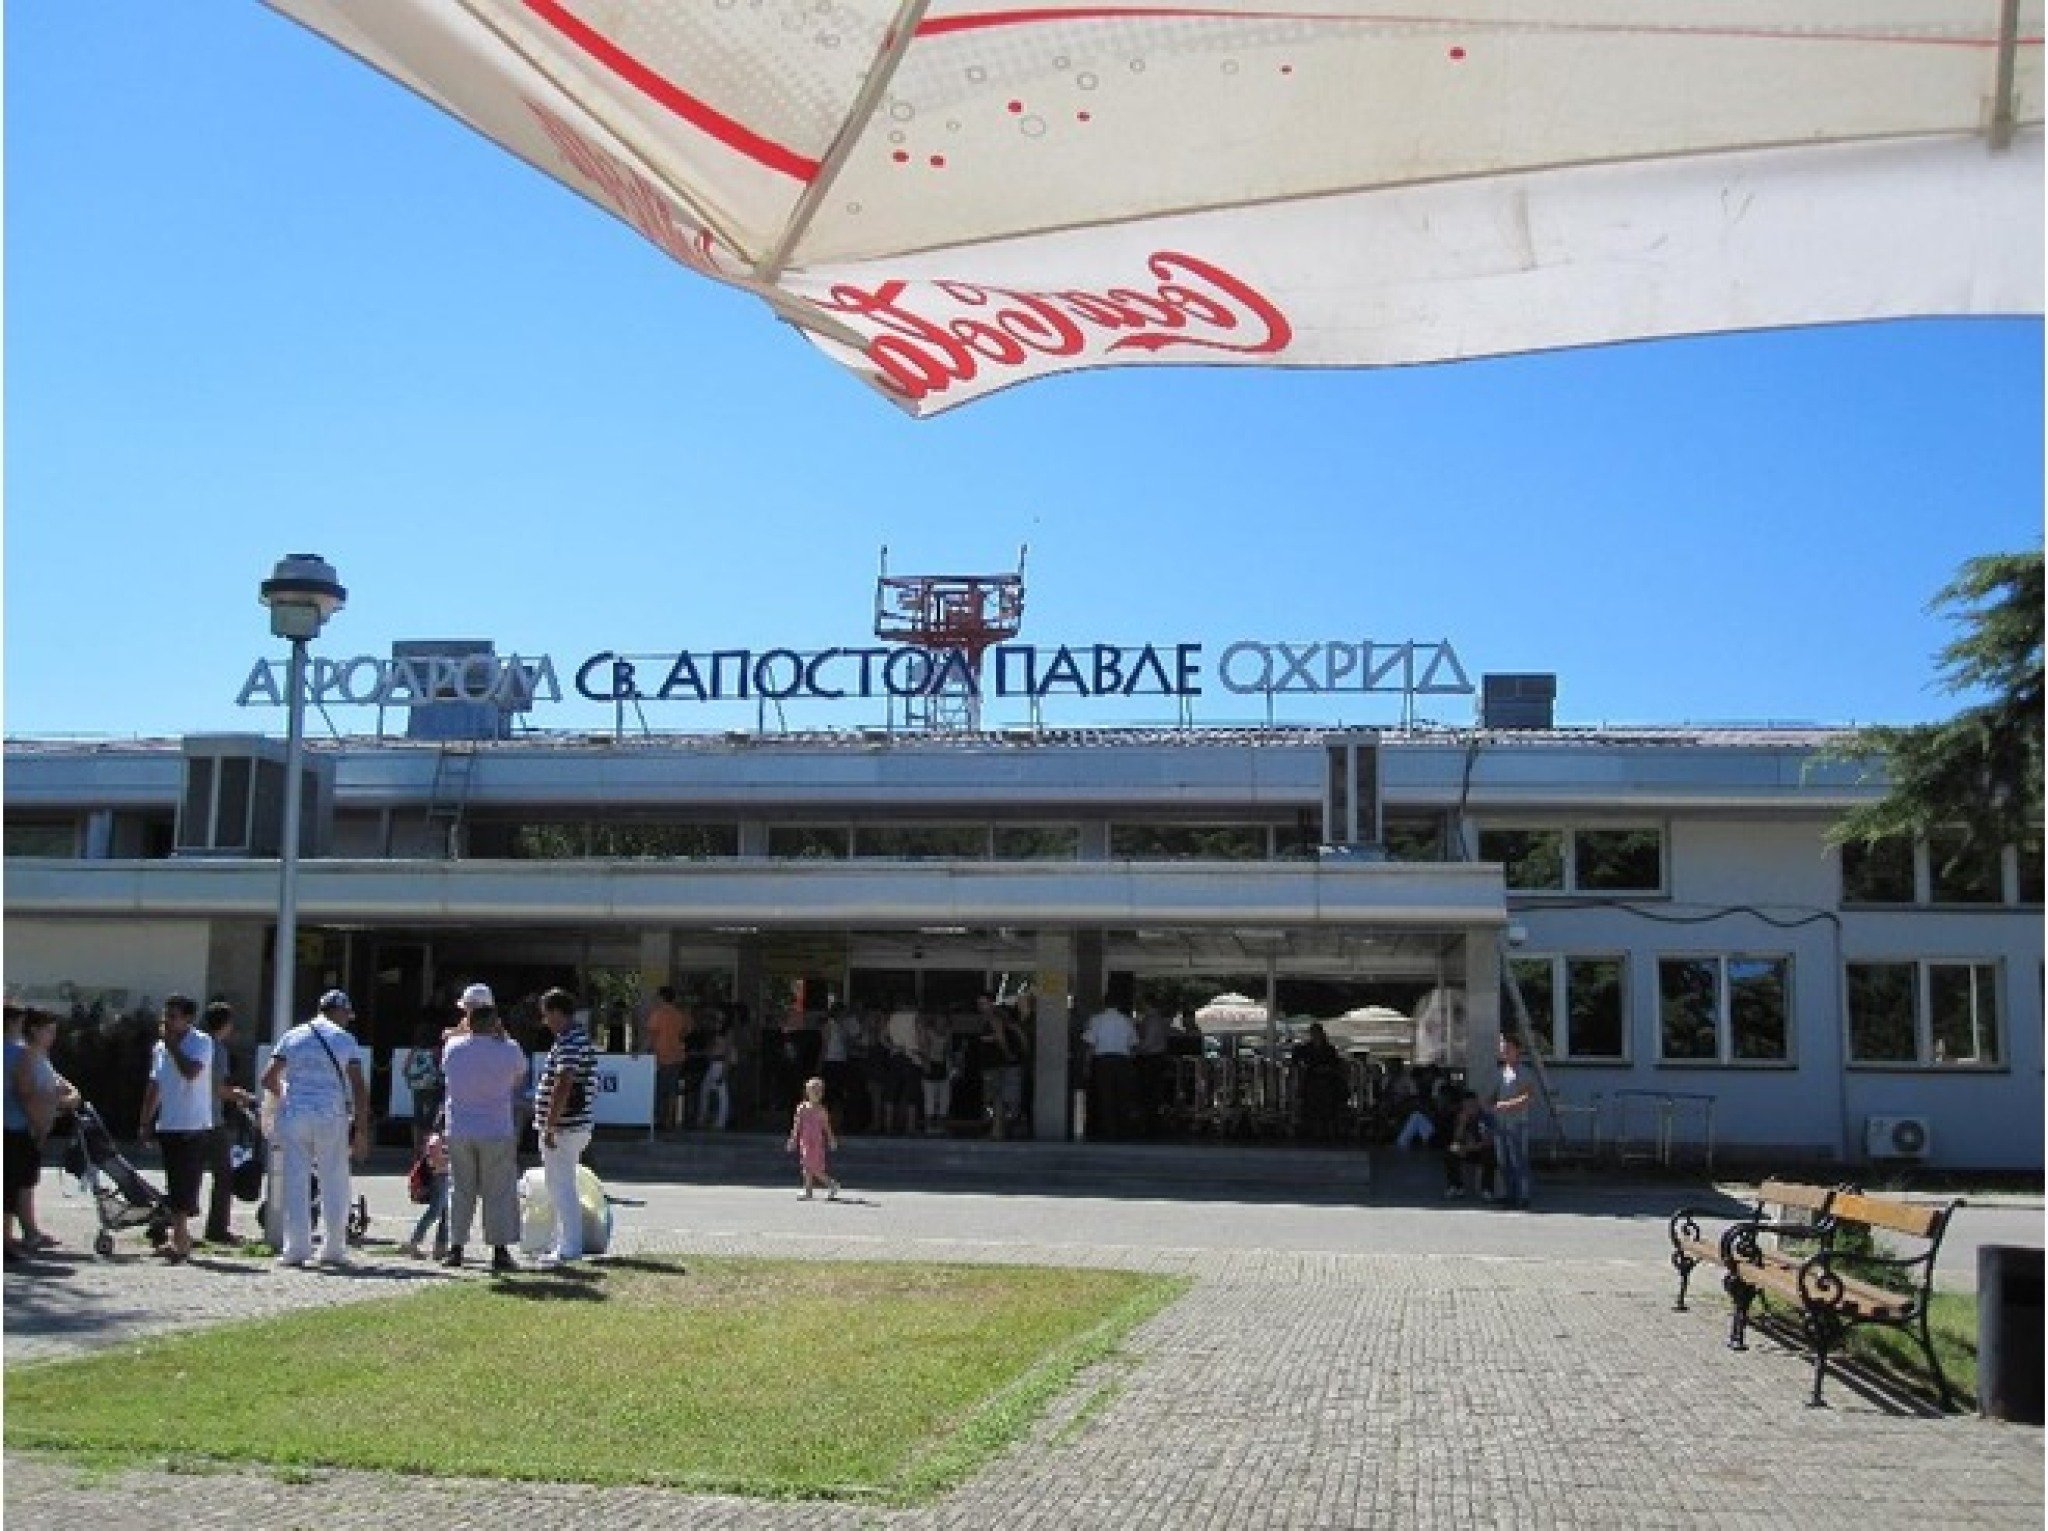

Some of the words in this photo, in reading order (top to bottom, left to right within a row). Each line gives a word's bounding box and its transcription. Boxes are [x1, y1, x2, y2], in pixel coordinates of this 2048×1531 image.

[657, 647, 979, 701] АПОСТОЛ
[995, 643, 1201, 697] ПАВЛЕ
[1219, 639, 1475, 695] ОХРИД
